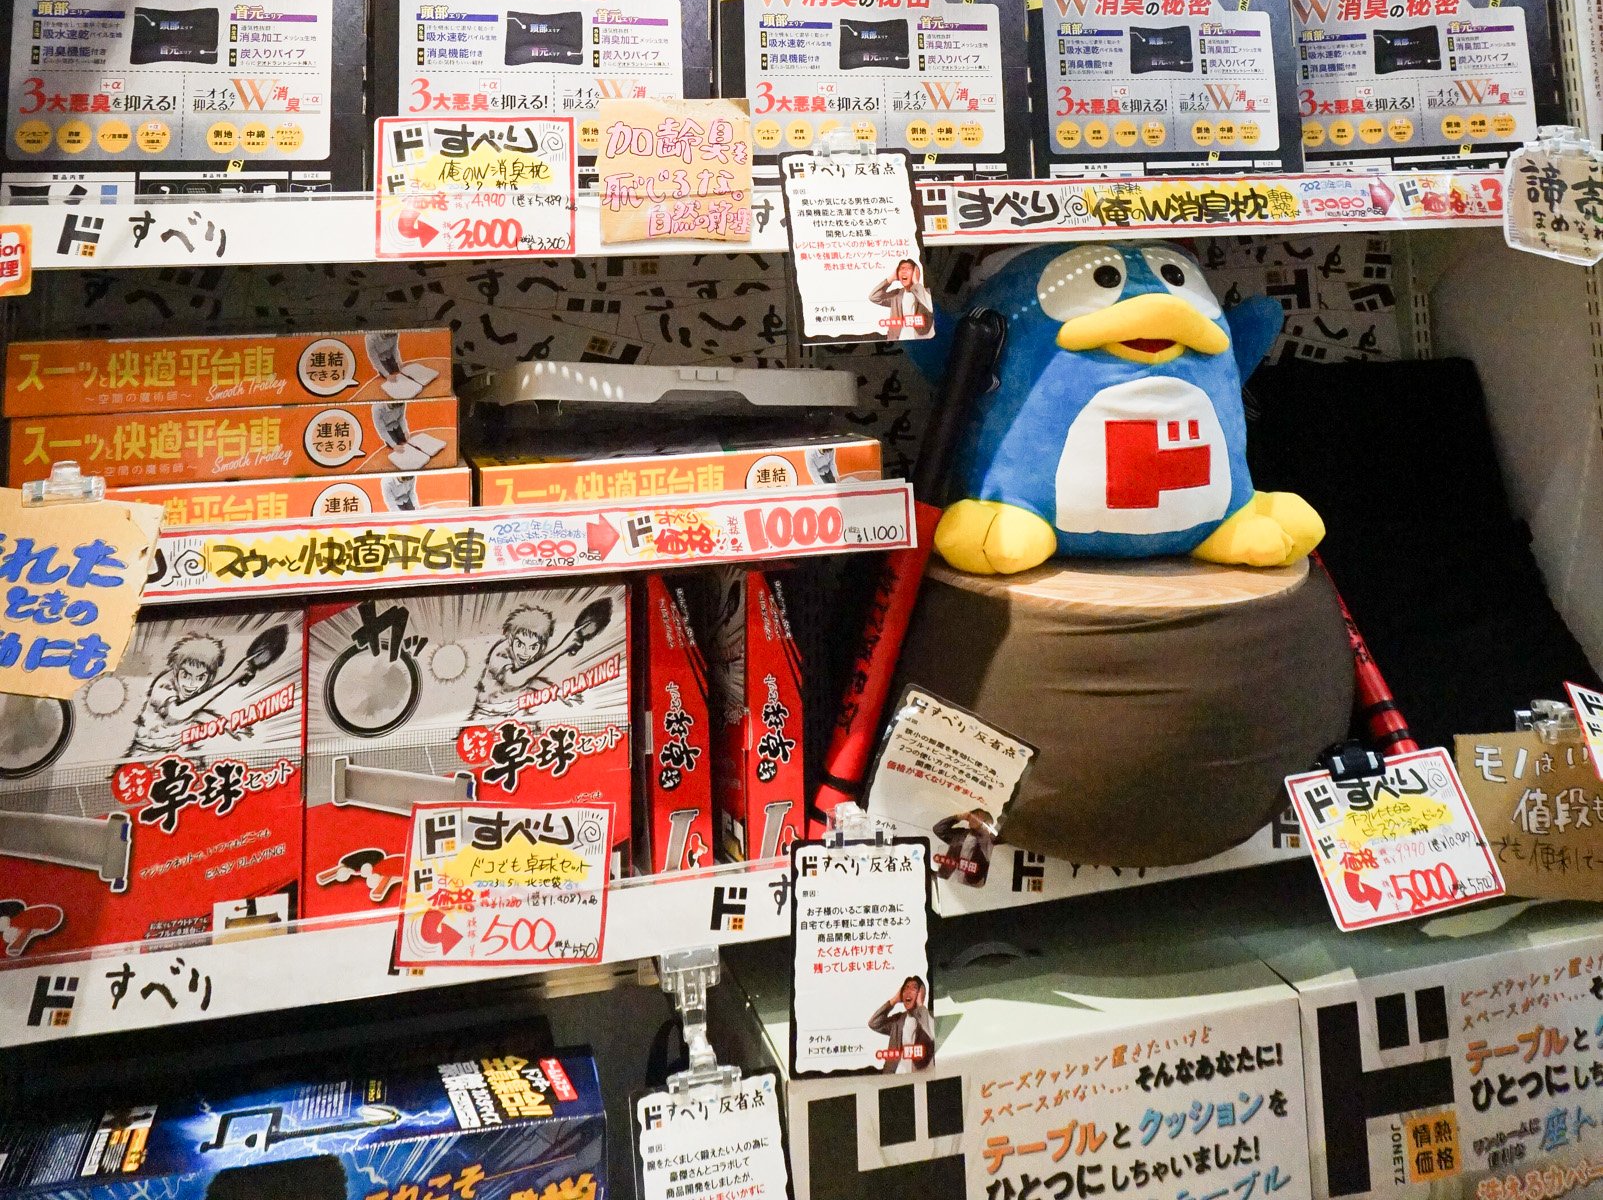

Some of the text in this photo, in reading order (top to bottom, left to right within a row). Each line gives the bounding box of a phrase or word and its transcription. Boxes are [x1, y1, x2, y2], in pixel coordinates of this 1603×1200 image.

[854, 161, 896, 177] 反省点
[309, 350, 344, 369] 連結
[205, 376, 289, 404] Smooth Trolley
[316, 421, 350, 440] 連結
[211, 448, 293, 476] Smooth Trolley
[755, 467, 787, 484] 連結
[325, 495, 359, 513] 連結
[743, 506, 843, 549] 1000
[0, 533, 128, 589] れた
[5, 585, 99, 627] ときの
[518, 652, 622, 710] ENJOY PLAYING!
[181, 683, 295, 744] ENJOY PLAYING!
[205, 859, 235, 880] EASY
[869, 855, 914, 873] 反省点
[480, 913, 557, 957] 500
[105, 957, 213, 1012] すべり
[719, 1089, 767, 1114] 反省点
[1390, 1124, 1406, 1185] JONETZ
